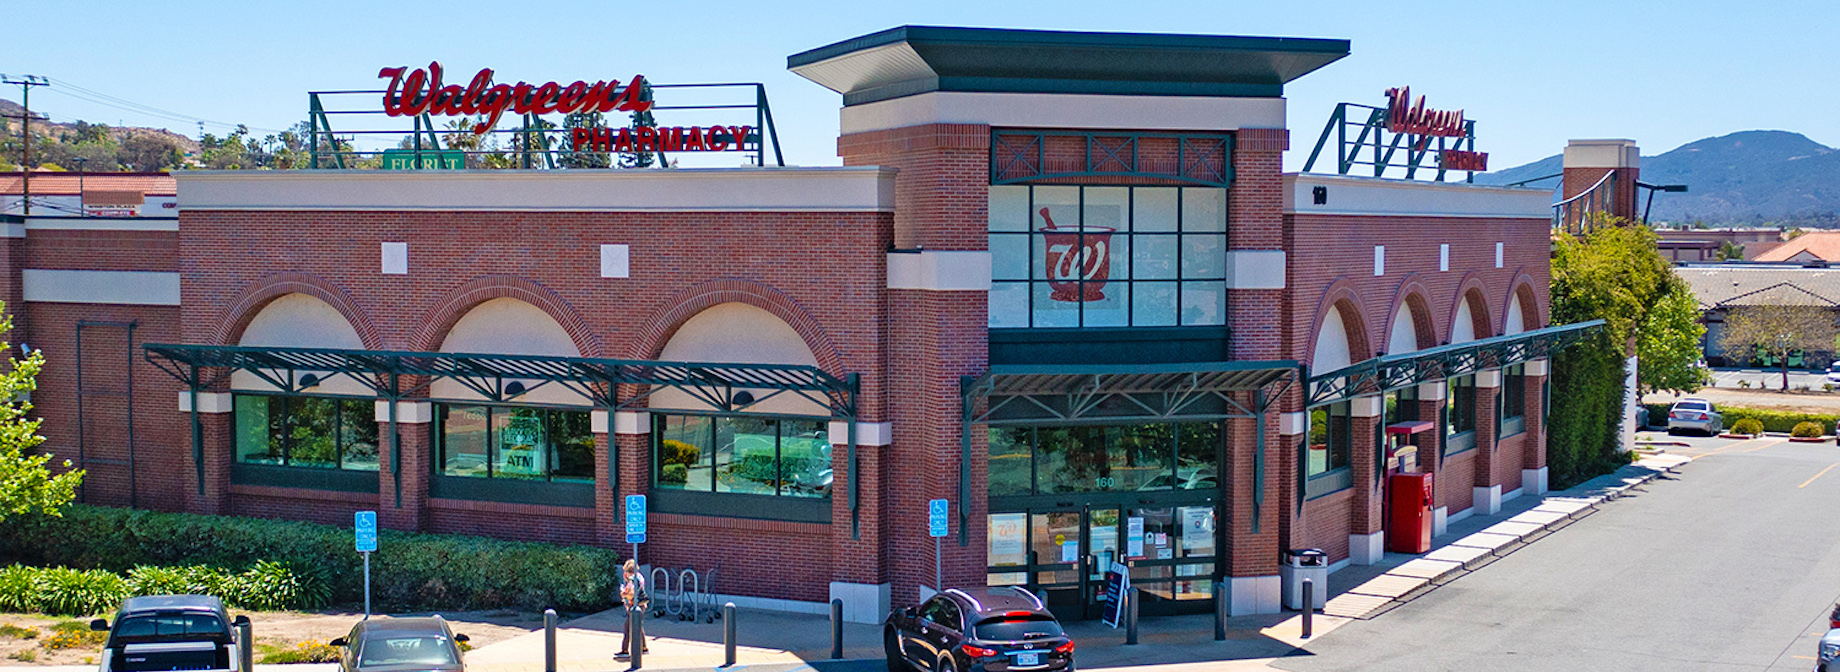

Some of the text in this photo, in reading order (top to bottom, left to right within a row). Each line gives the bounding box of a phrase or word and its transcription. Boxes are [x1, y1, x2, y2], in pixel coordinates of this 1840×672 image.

[378, 61, 654, 135] Walgreens
[1384, 85, 1466, 151] Walgreens
[573, 125, 752, 153] PHARMACY
[1048, 240, 1106, 284] W
[507, 455, 534, 468] ATM
[1095, 477, 1114, 488] 160
